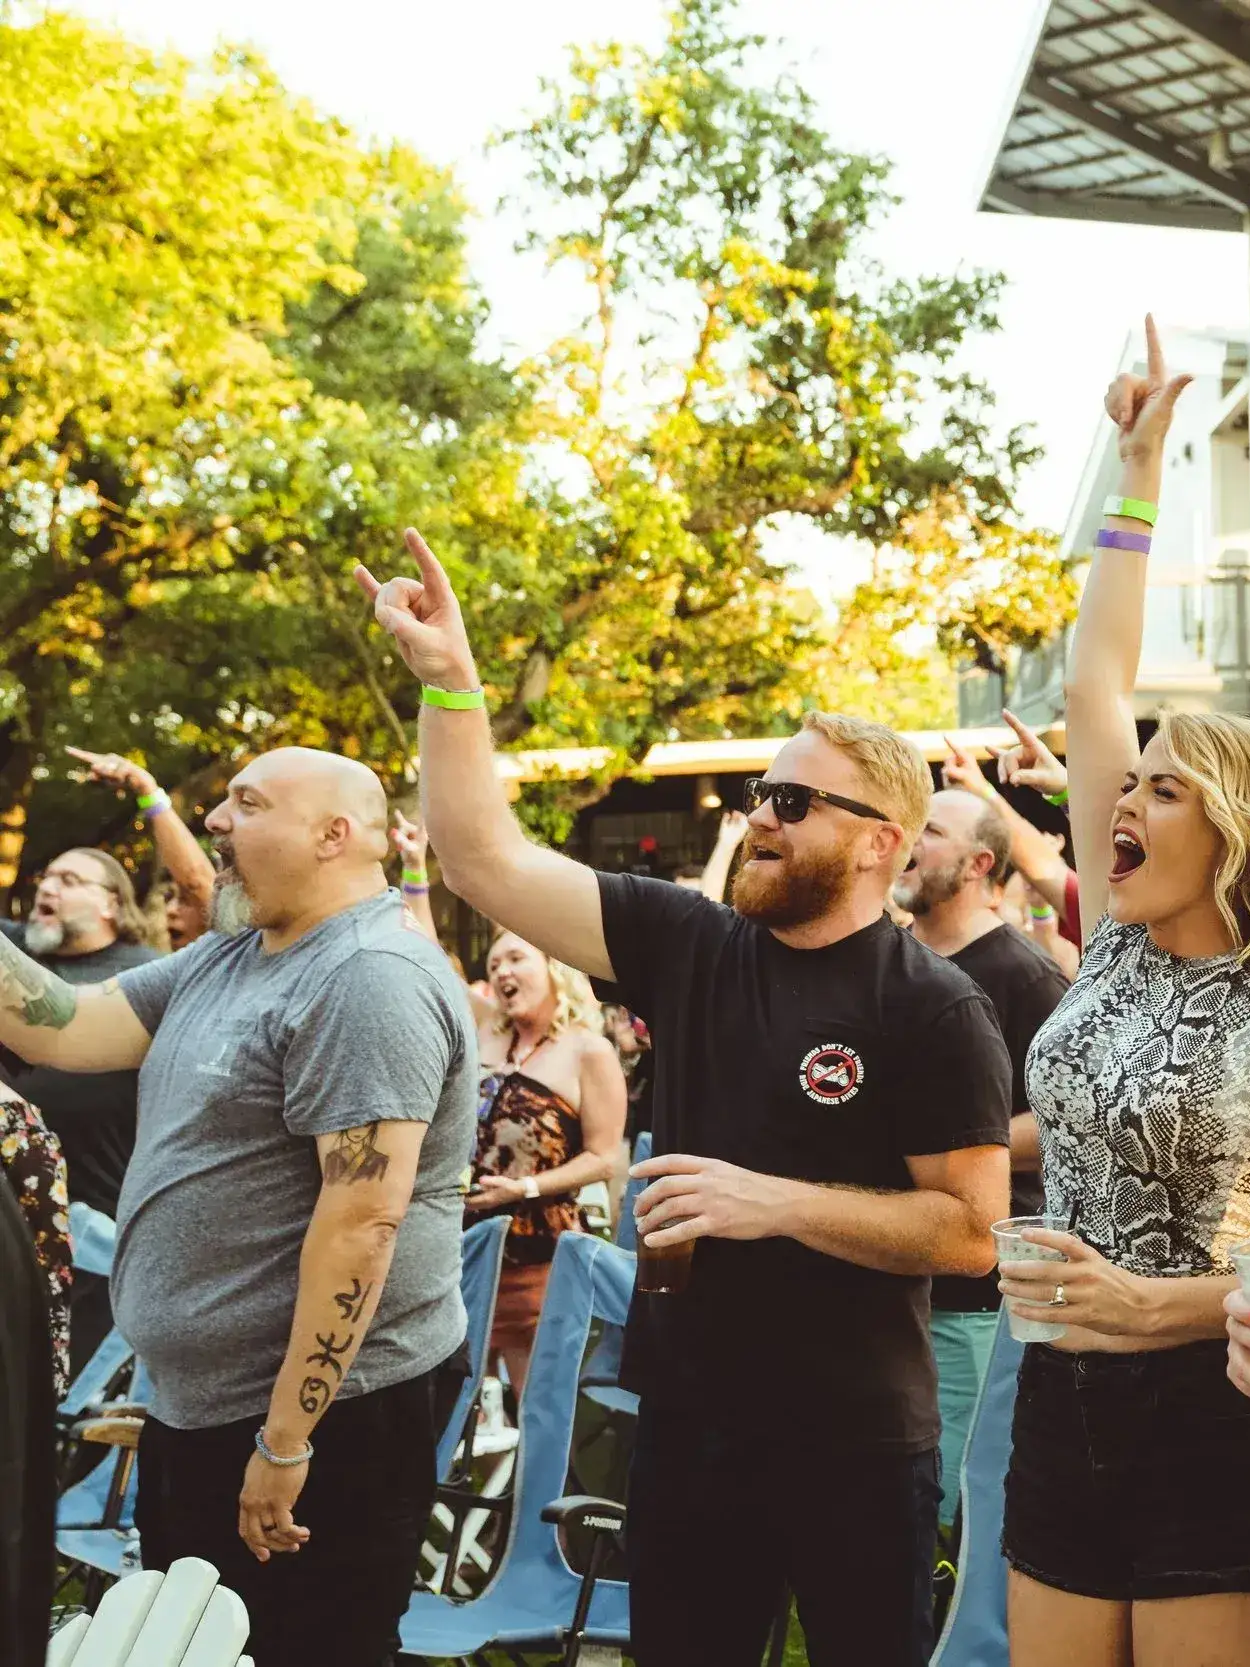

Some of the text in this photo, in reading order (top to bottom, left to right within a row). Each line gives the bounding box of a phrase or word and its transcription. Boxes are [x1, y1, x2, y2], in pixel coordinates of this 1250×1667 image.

[800, 1043, 865, 1084] FRIENDS DON'T LET FRIENDS
[799, 1074, 859, 1105] RIDE JAPANESE BIKES
[582, 1515, 622, 1530] 3-POSITION
